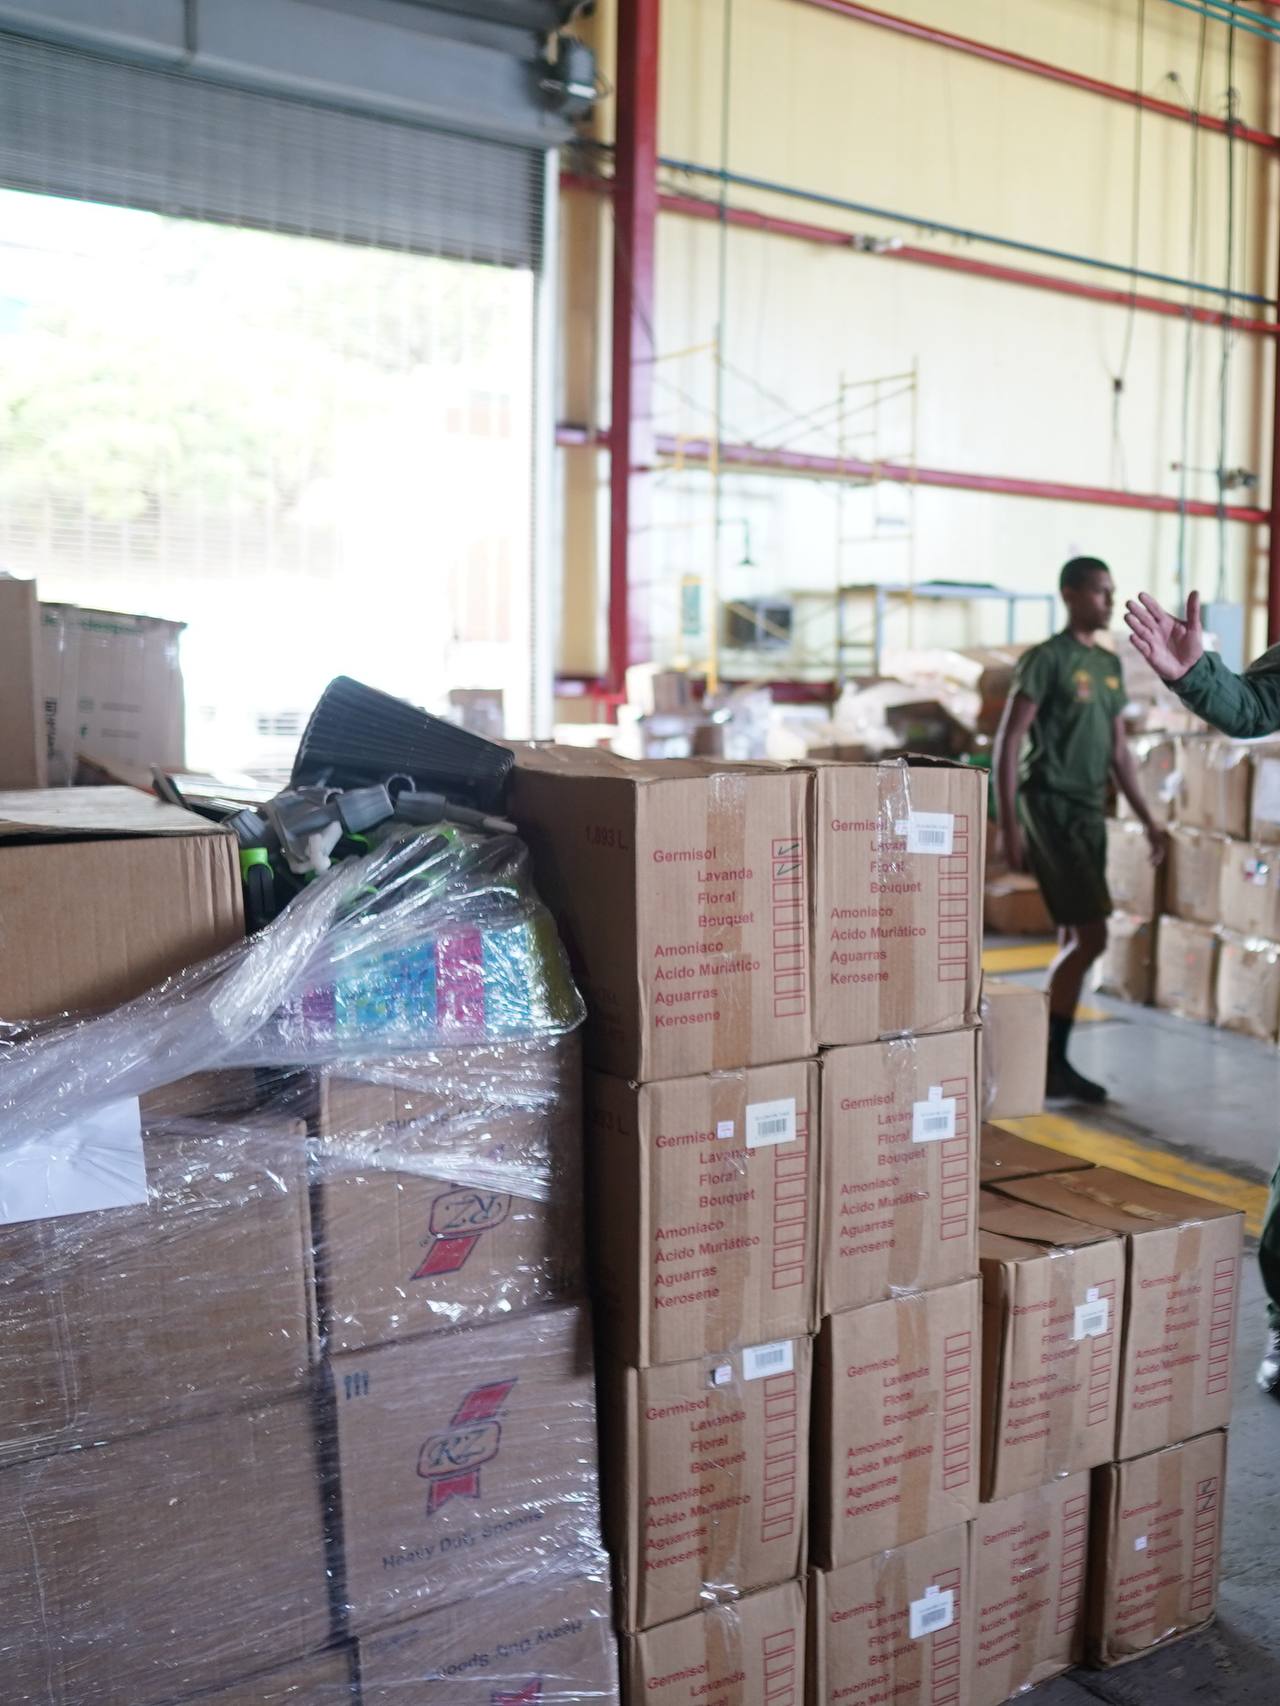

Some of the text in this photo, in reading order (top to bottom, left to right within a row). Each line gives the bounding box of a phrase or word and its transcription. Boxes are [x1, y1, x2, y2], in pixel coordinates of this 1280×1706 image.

[870, 839, 907, 852] Lavan
[653, 846, 716, 864] Germisol
[697, 867, 753, 883] Lavanda
[870, 881, 921, 894] Bouquet
[697, 891, 736, 904] Floral
[698, 912, 754, 929] Bouquet
[831, 907, 893, 920] Amoniaco
[654, 940, 723, 958] Amoniaco
[831, 950, 886, 965] Aguarras
[655, 960, 760, 981] Ácido Muriático
[831, 970, 888, 985] Kerosene
[655, 987, 718, 1006] Aguarras
[655, 1010, 720, 1028] Kerosene
[841, 1092, 894, 1110] Germisol
[878, 1111, 912, 1126] Lavan
[656, 1131, 717, 1149] Germiso
[878, 1149, 927, 1166] Bouquet
[699, 1171, 737, 1185] Floral
[840, 1176, 899, 1195] Amoniaco
[699, 1190, 755, 1207] Bouquet
[656, 1220, 724, 1241] Amoniaco
[840, 1218, 894, 1238] Aguarras
[840, 1238, 896, 1257] Kerosene
[655, 1266, 717, 1287] Aguarras
[655, 1286, 719, 1308] Kerosene
[647, 1663, 709, 1690] Germisol
[690, 1671, 746, 1696] Lavanda
